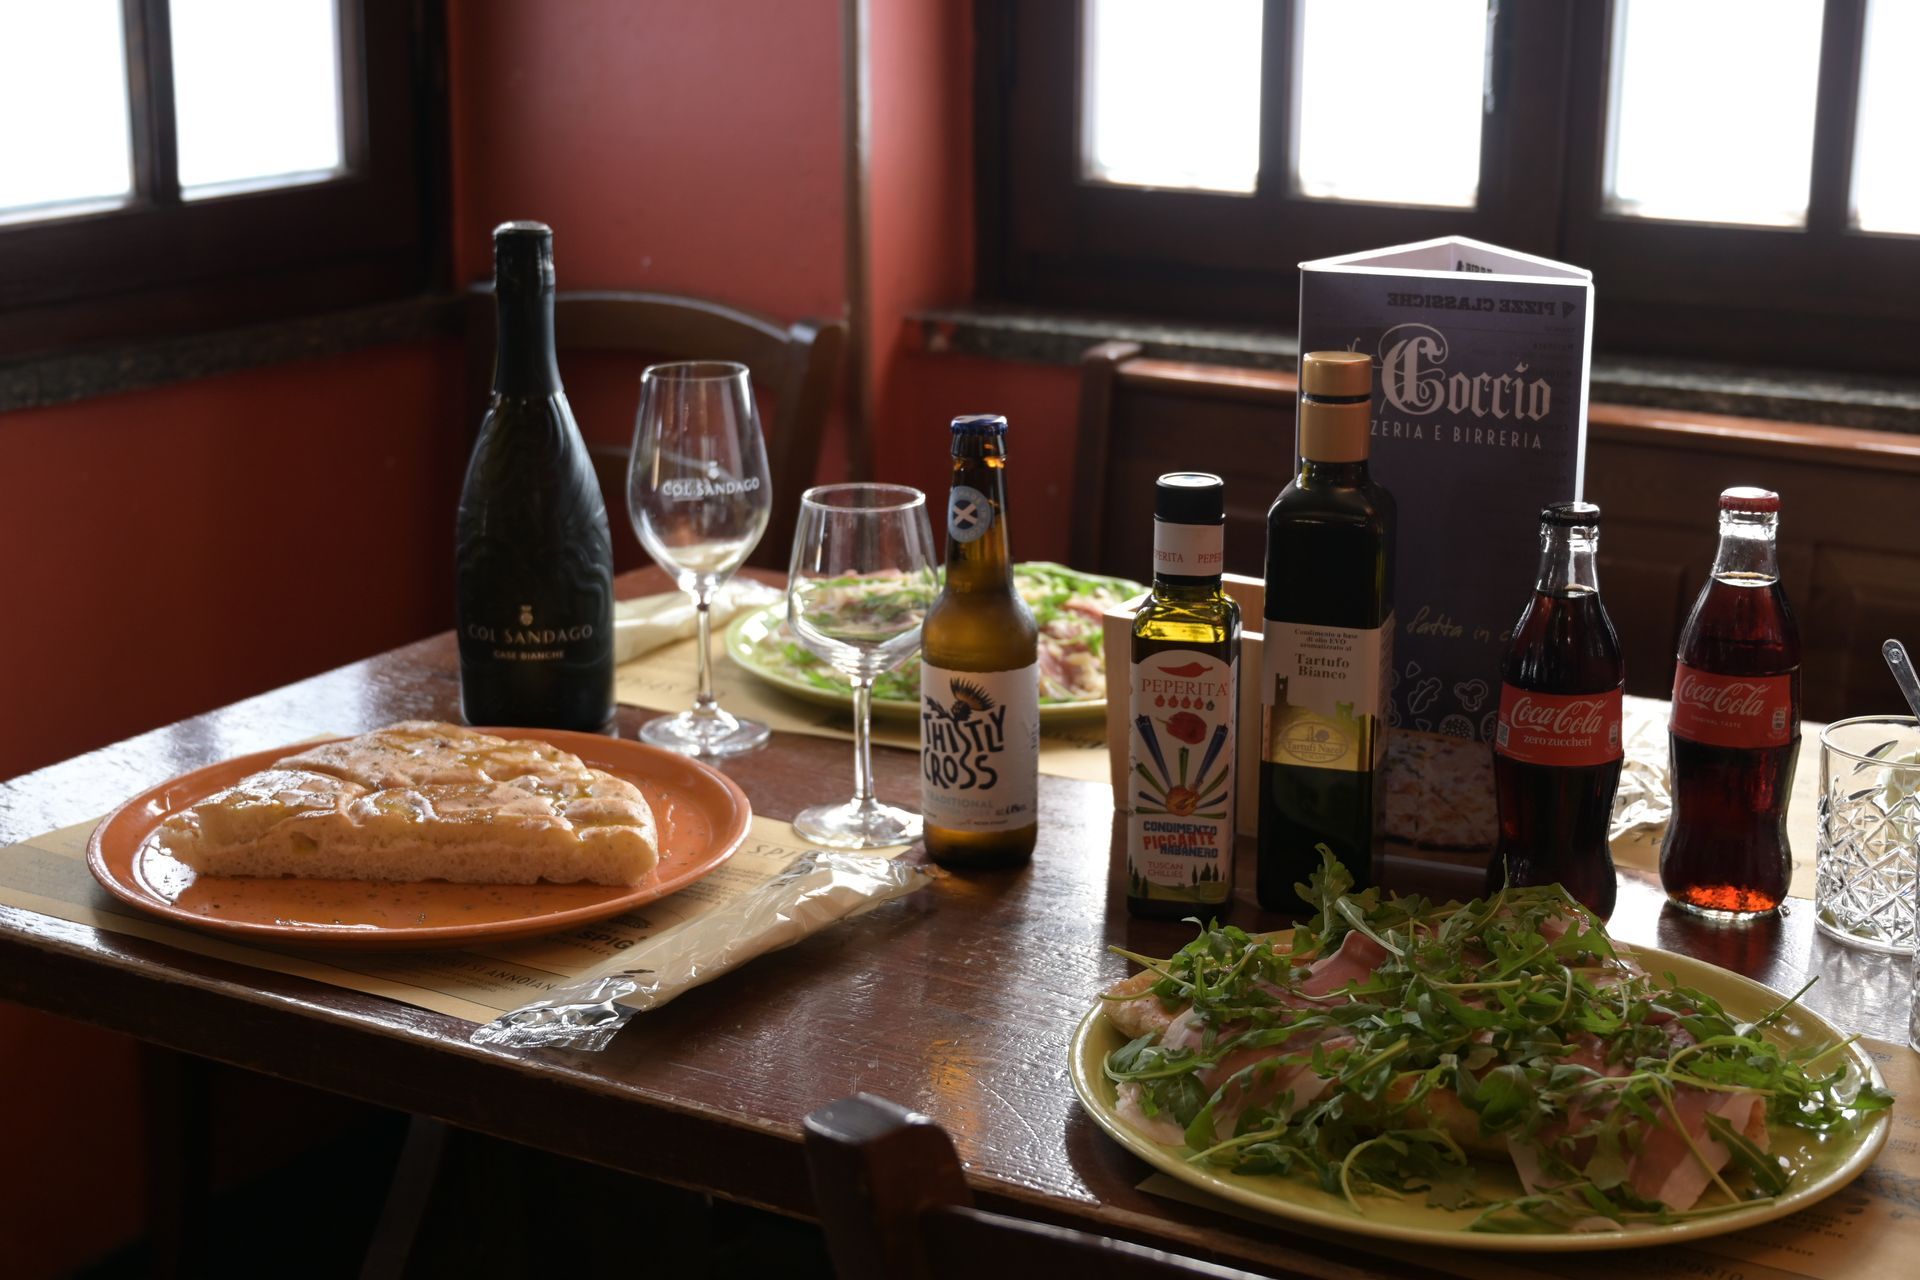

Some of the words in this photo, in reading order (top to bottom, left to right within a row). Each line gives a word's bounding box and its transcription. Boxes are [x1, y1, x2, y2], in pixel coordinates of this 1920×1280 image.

[1370, 420, 1423, 440] ZERIA
[1434, 424, 1442, 441] E
[1453, 426, 1542, 449] BIRRERIA
[696, 476, 761, 498] SANDAGO
[1157, 550, 1184, 563] ERITA
[468, 623, 496, 642] COL
[503, 623, 592, 645] SANDAGO
[1294, 652, 1350, 669] Tartufo
[1298, 665, 1347, 680] Bianco
[1141, 678, 1228, 697] PEPERITA
[1679, 674, 1771, 717] Coca-Cola
[1510, 696, 1608, 735] Coca-Cola
[923, 704, 1007, 753] THISTLY
[1523, 735, 1546, 747] zero
[1546, 736, 1592, 748] zuccheri
[923, 746, 999, 791] CROSS
[1143, 821, 1218, 836] CONDIMENTO
[1143, 831, 1216, 850] PICCANTE
[1159, 843, 1218, 858] HABANERO
[1147, 861, 1184, 871] TUSCAN
